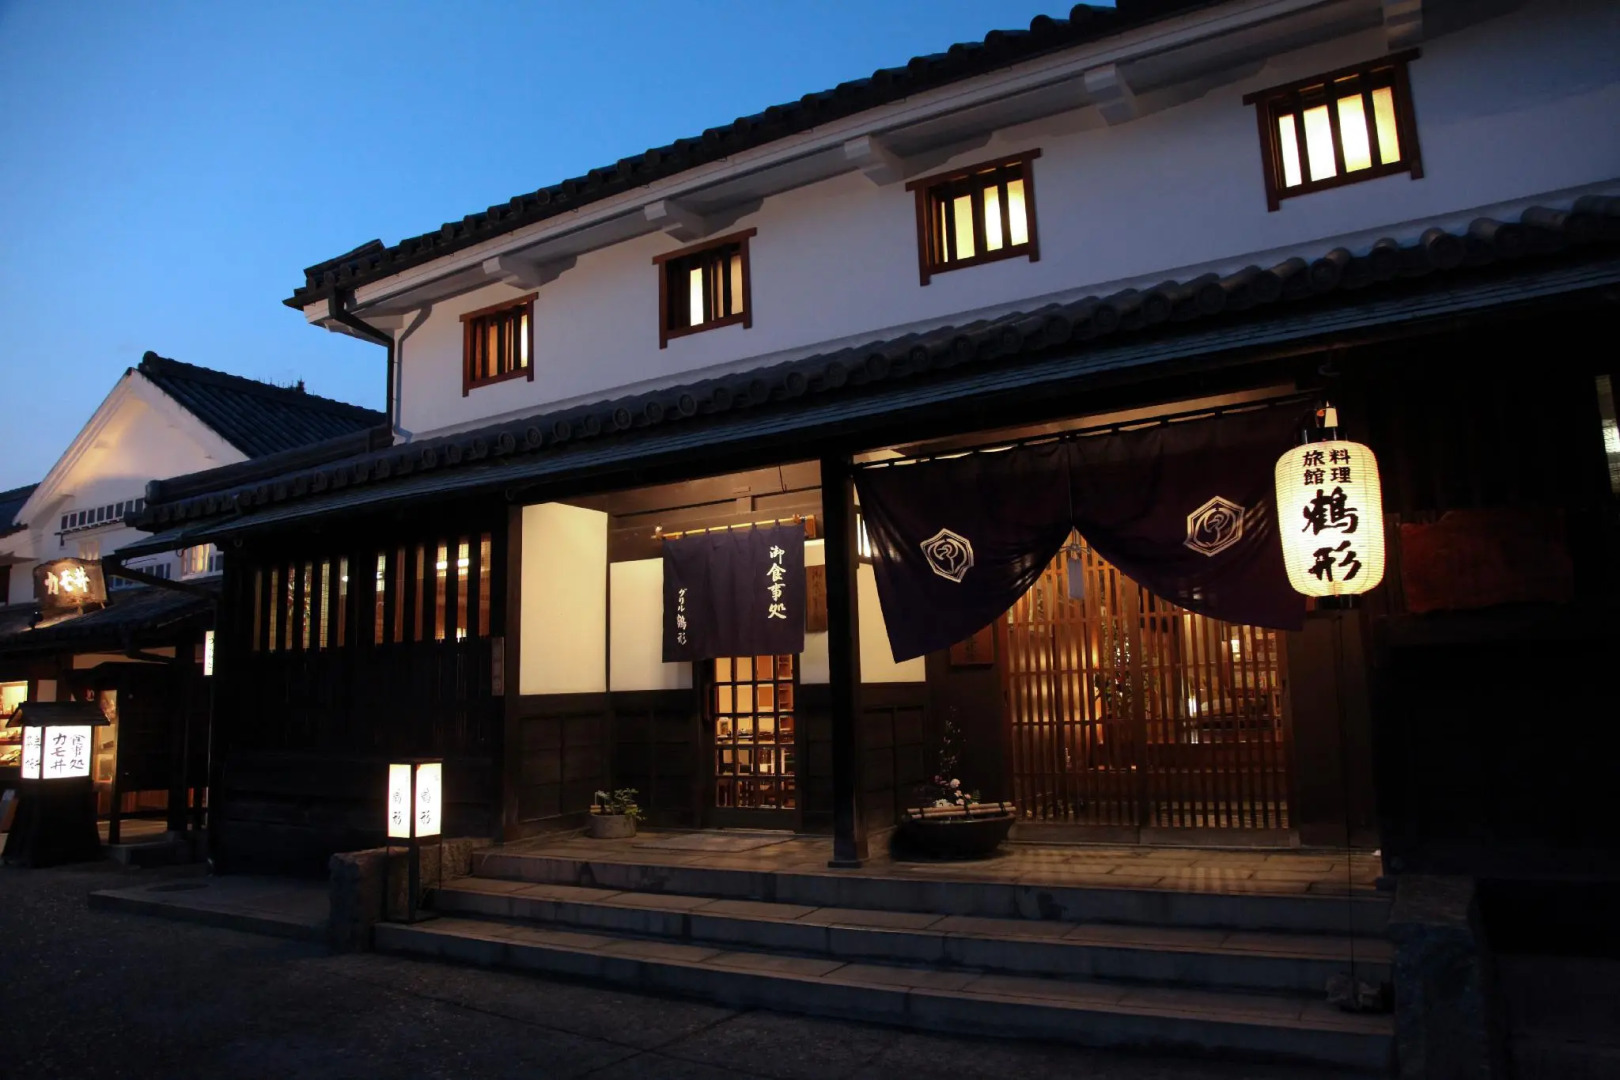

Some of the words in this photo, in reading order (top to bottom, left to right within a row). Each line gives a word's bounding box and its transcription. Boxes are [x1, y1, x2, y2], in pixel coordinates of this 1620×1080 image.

[1302, 449, 1327, 486] 旅館
[1328, 448, 1353, 484] 料理
[1302, 486, 1362, 582] 鶴形
[766, 545, 787, 620] 御食事処
[676, 588, 688, 646] グリル鶴形
